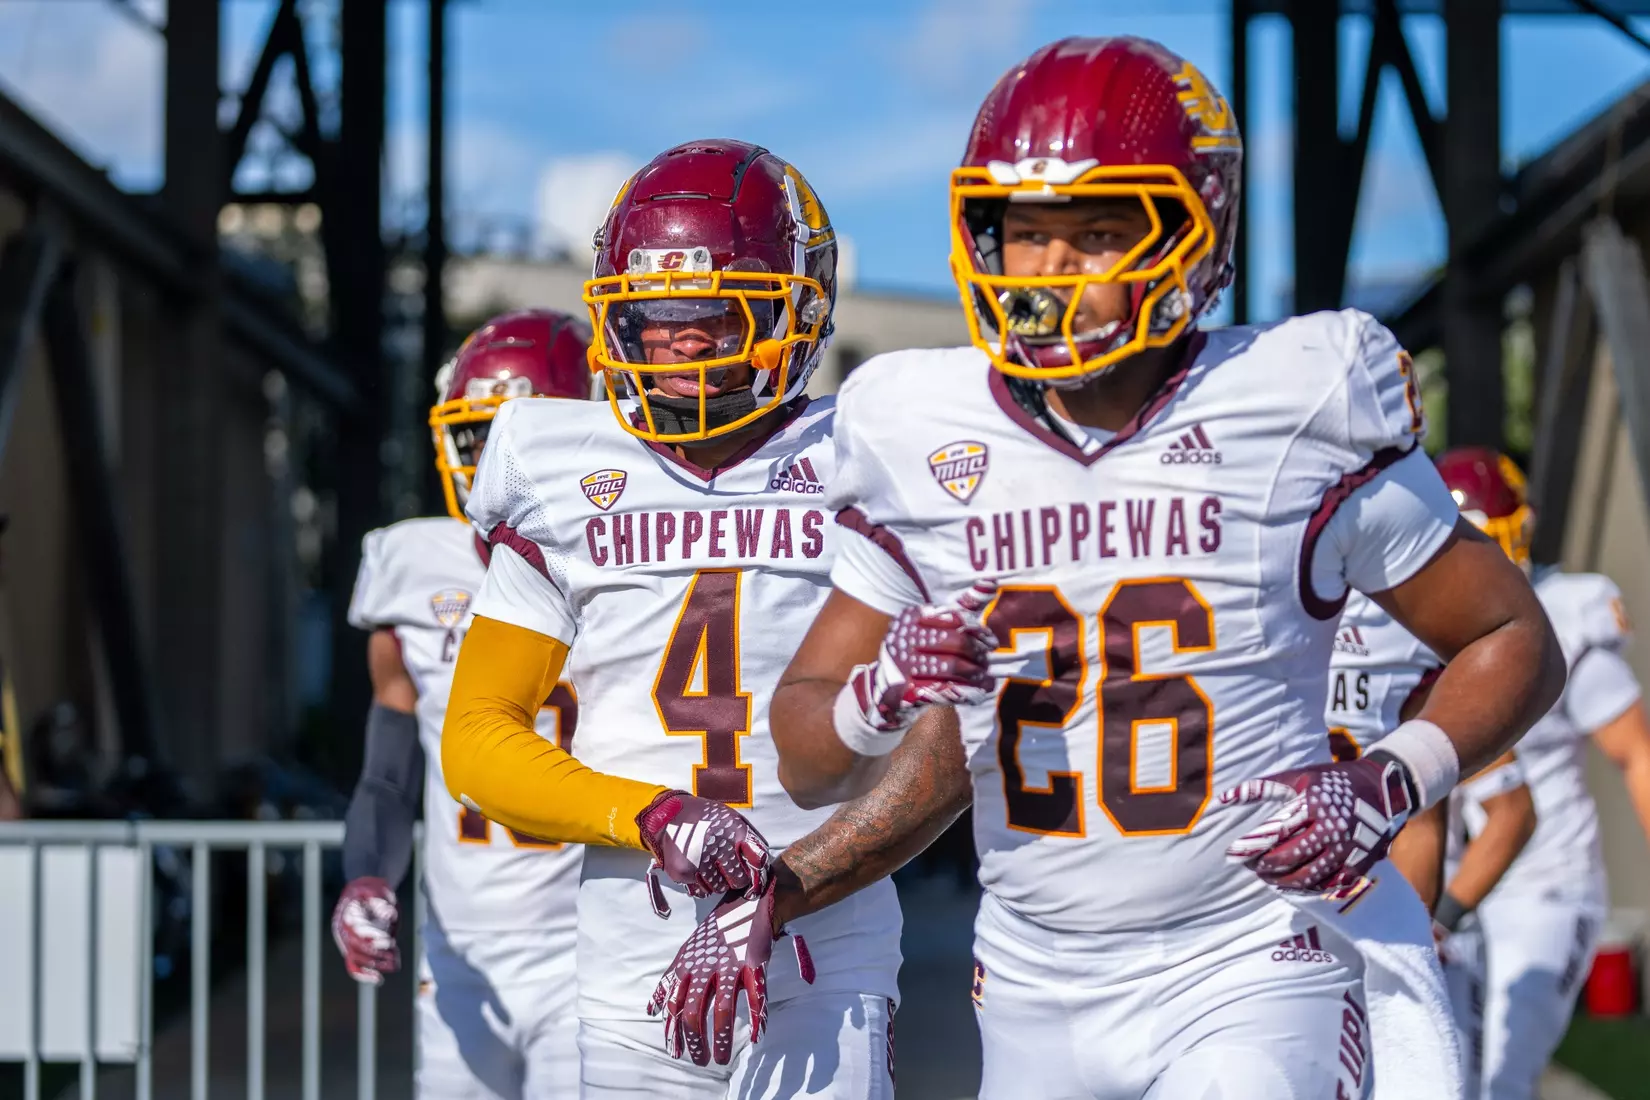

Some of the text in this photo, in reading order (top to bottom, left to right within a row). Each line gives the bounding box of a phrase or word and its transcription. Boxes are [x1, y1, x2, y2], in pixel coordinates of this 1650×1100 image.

[935, 457, 989, 482] MAC
[1160, 450, 1222, 465] adidas
[584, 479, 624, 497] MAC
[771, 476, 825, 494] adidas
[585, 508, 825, 567] CHIPPEWAS
[966, 496, 1222, 572] CHIPPEWAS
[651, 567, 753, 809] 4
[981, 575, 1217, 839] 26
[1271, 947, 1333, 963] adidas
